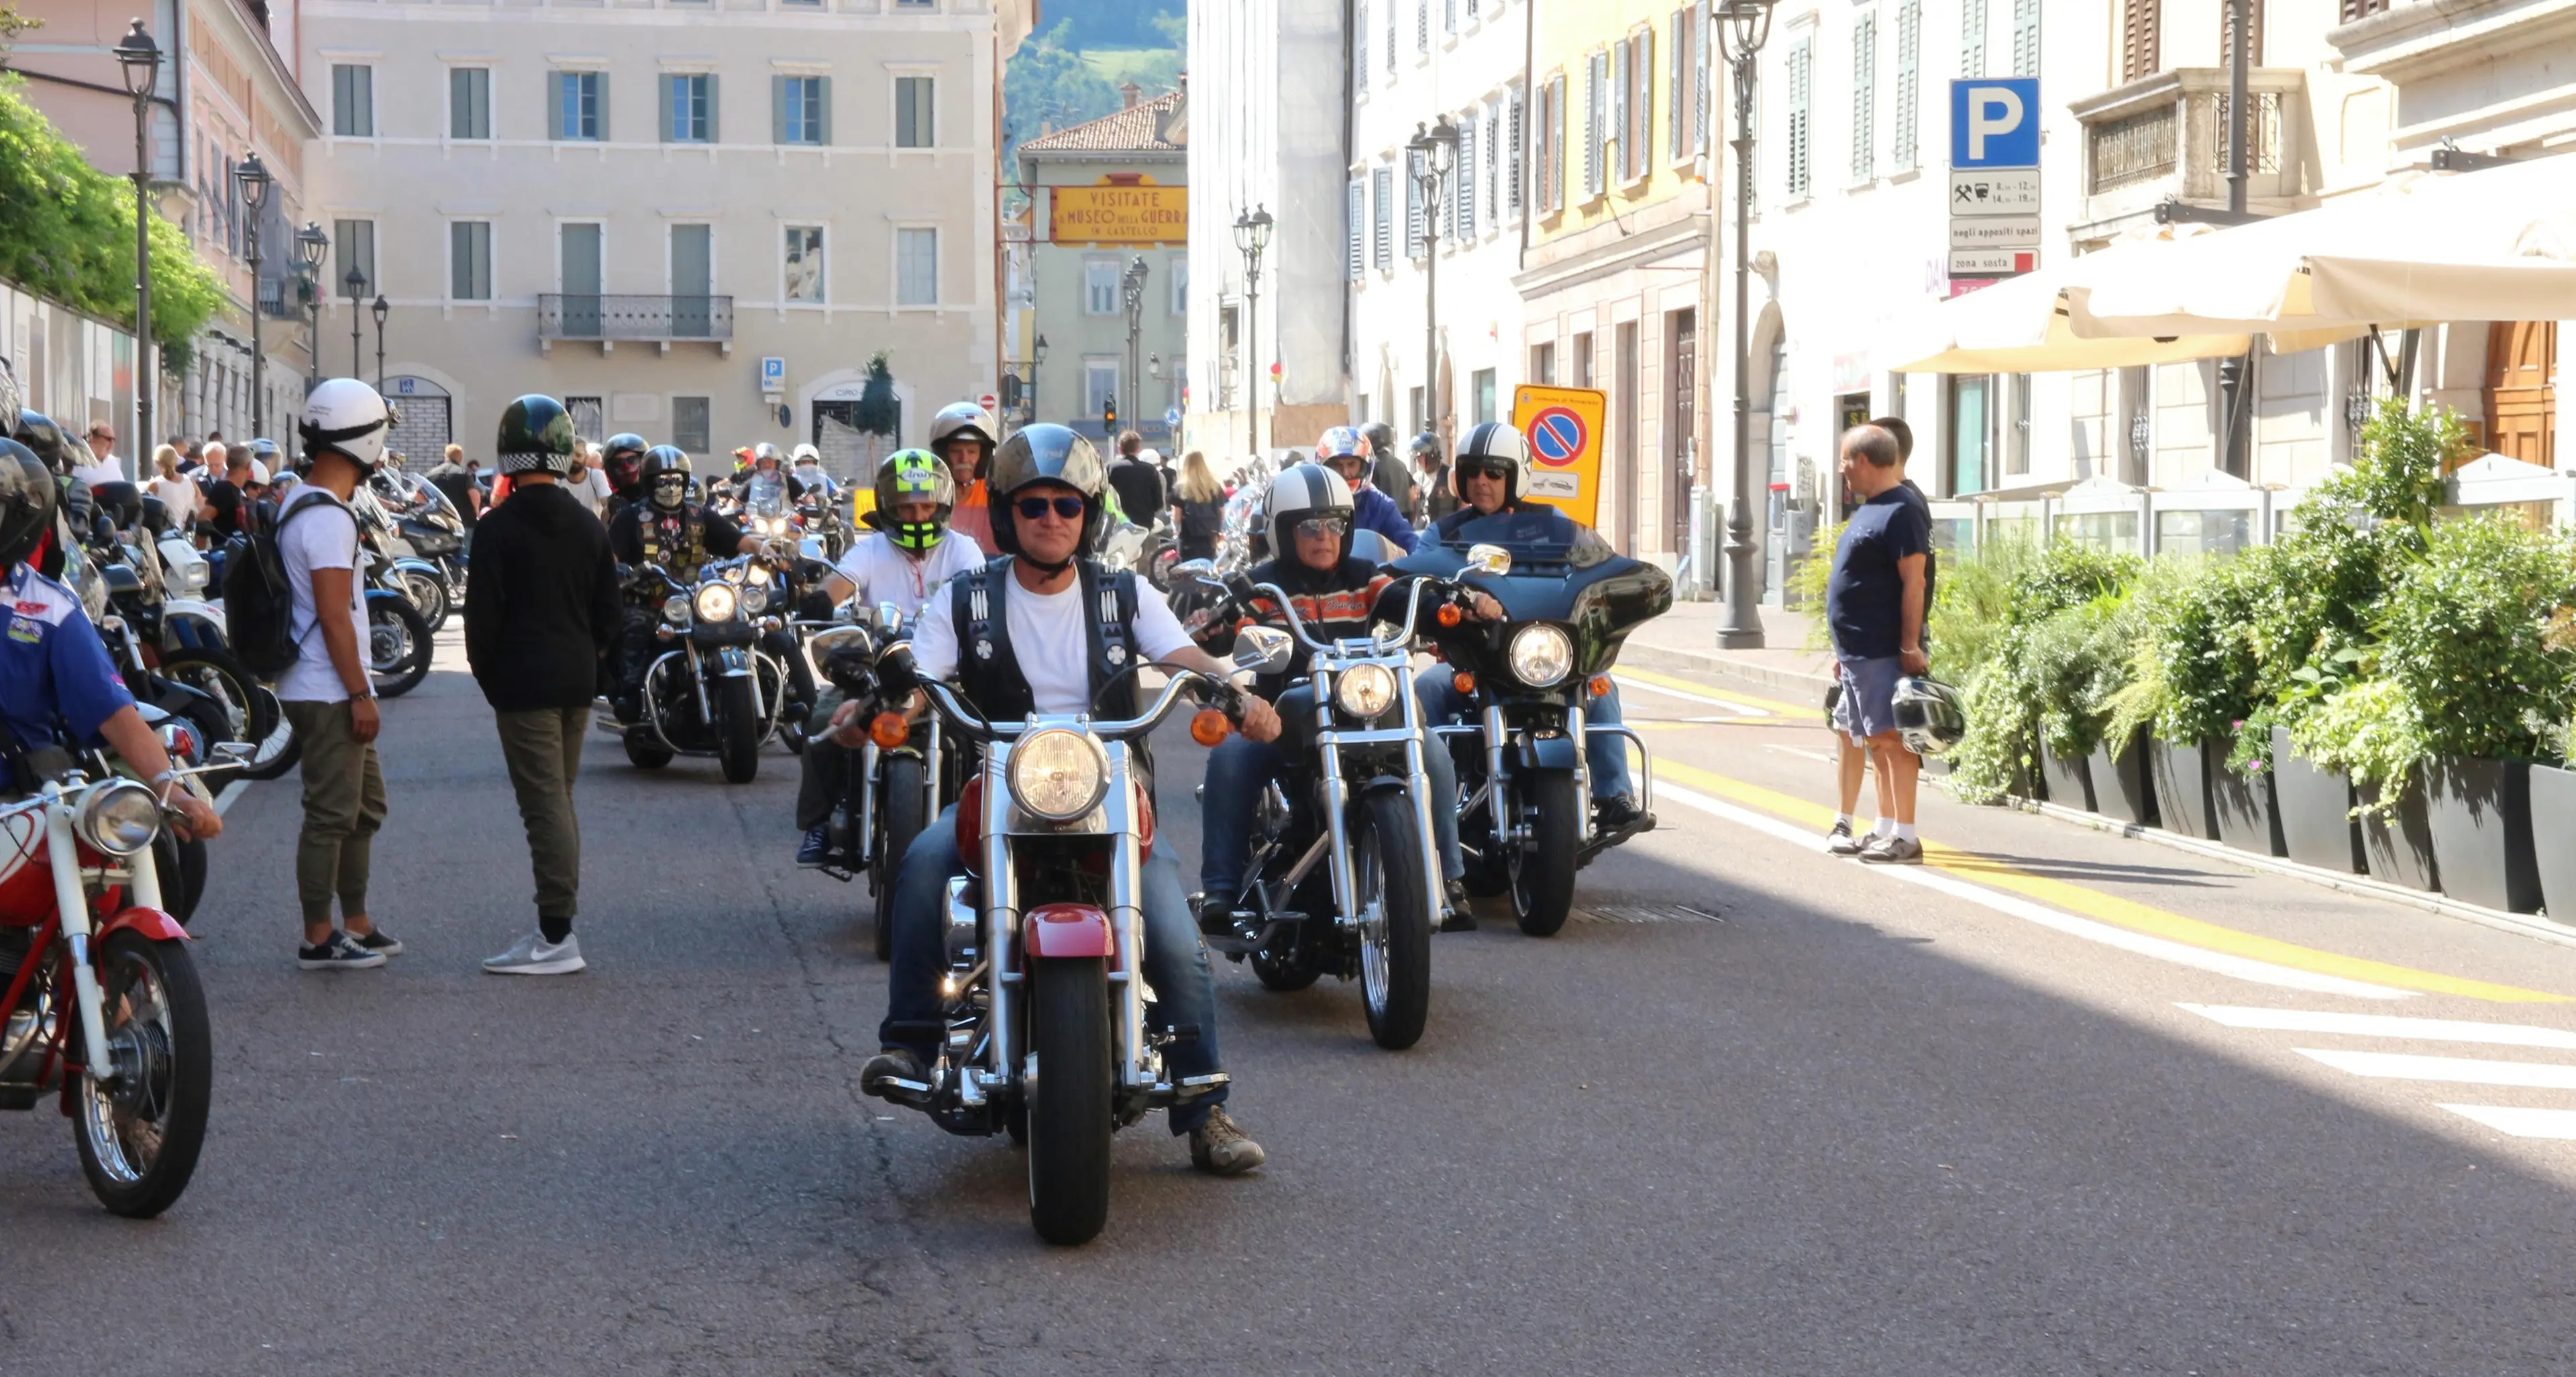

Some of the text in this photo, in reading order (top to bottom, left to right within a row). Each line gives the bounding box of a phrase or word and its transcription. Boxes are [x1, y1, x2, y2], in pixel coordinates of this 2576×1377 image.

[1968, 87, 2023, 160] P
[1090, 192, 1160, 207] VISITATE
[1067, 209, 1116, 225] MUSEO
[1108, 226, 1157, 236] CASTELLO
[1953, 227, 2038, 239] negli appositi spazi
[1955, 258, 2008, 268] zona sosta
[769, 362, 777, 374] P
